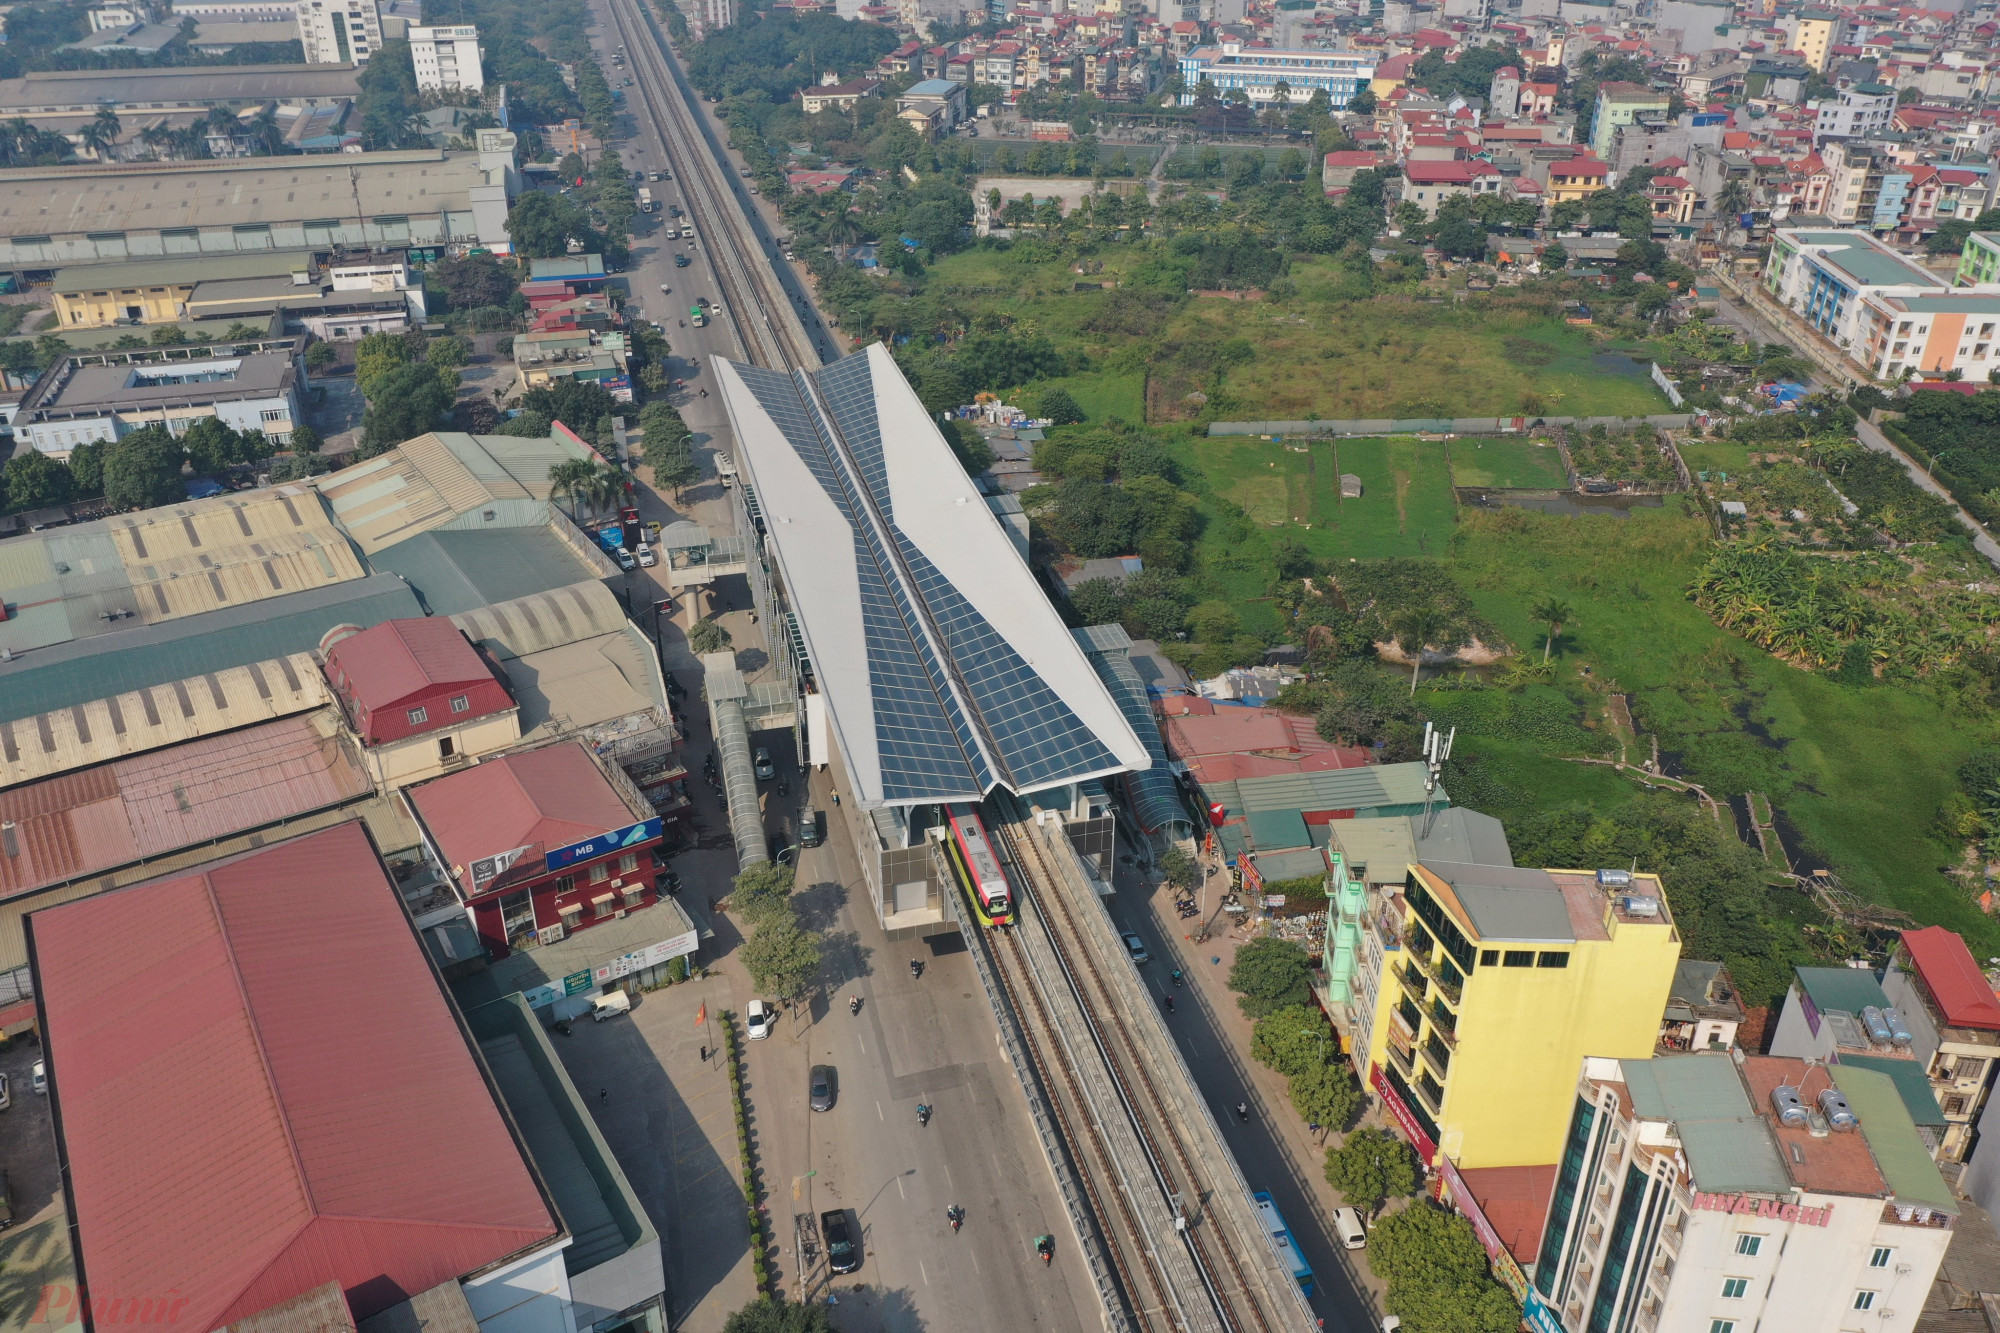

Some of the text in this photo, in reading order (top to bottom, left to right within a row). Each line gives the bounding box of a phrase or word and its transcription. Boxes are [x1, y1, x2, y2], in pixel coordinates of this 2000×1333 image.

[575, 844, 594, 857] MB
[1387, 1096, 1420, 1145] AGRIBANK
[1693, 1191, 1750, 1215] NHÀ
